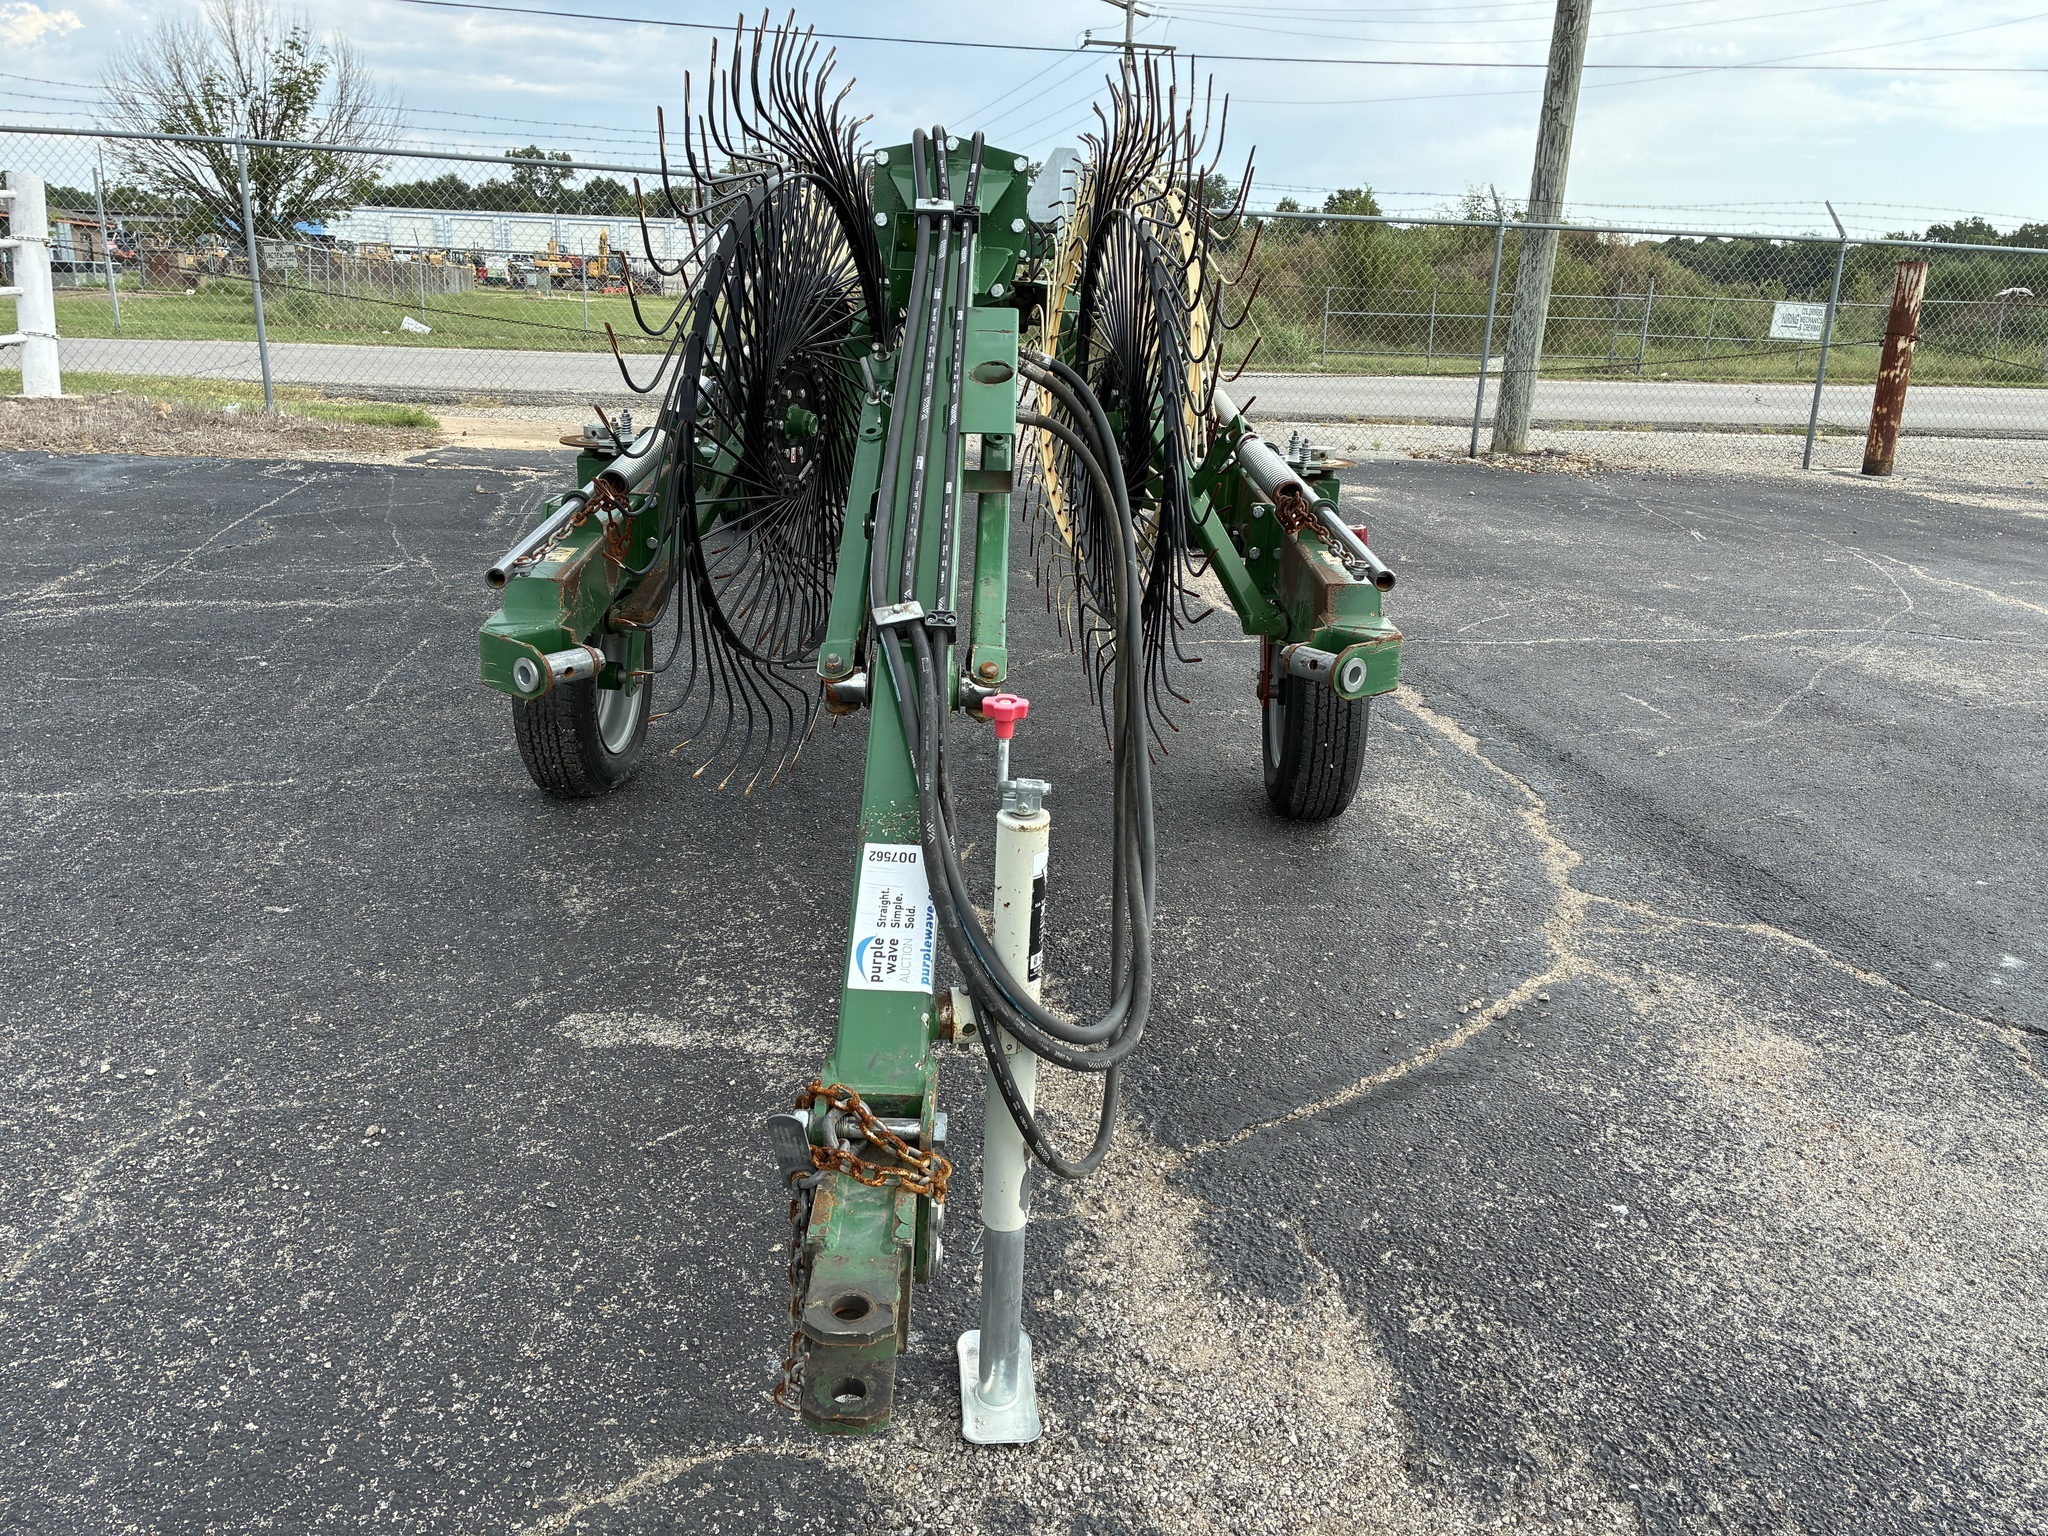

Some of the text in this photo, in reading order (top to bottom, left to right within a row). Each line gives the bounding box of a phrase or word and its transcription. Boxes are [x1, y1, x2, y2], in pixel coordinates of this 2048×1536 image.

[1781, 313, 1800, 325] HIRING
[1800, 316, 1824, 325] MECHANICS
[876, 887, 891, 928] Straight.
[890, 893, 904, 929] Simple.
[904, 905, 916, 929] Sold.
[886, 938, 899, 975] wave
[920, 892, 935, 986] purplewave.c
[870, 937, 887, 983] purple
[899, 938, 913, 984] AUCTION
